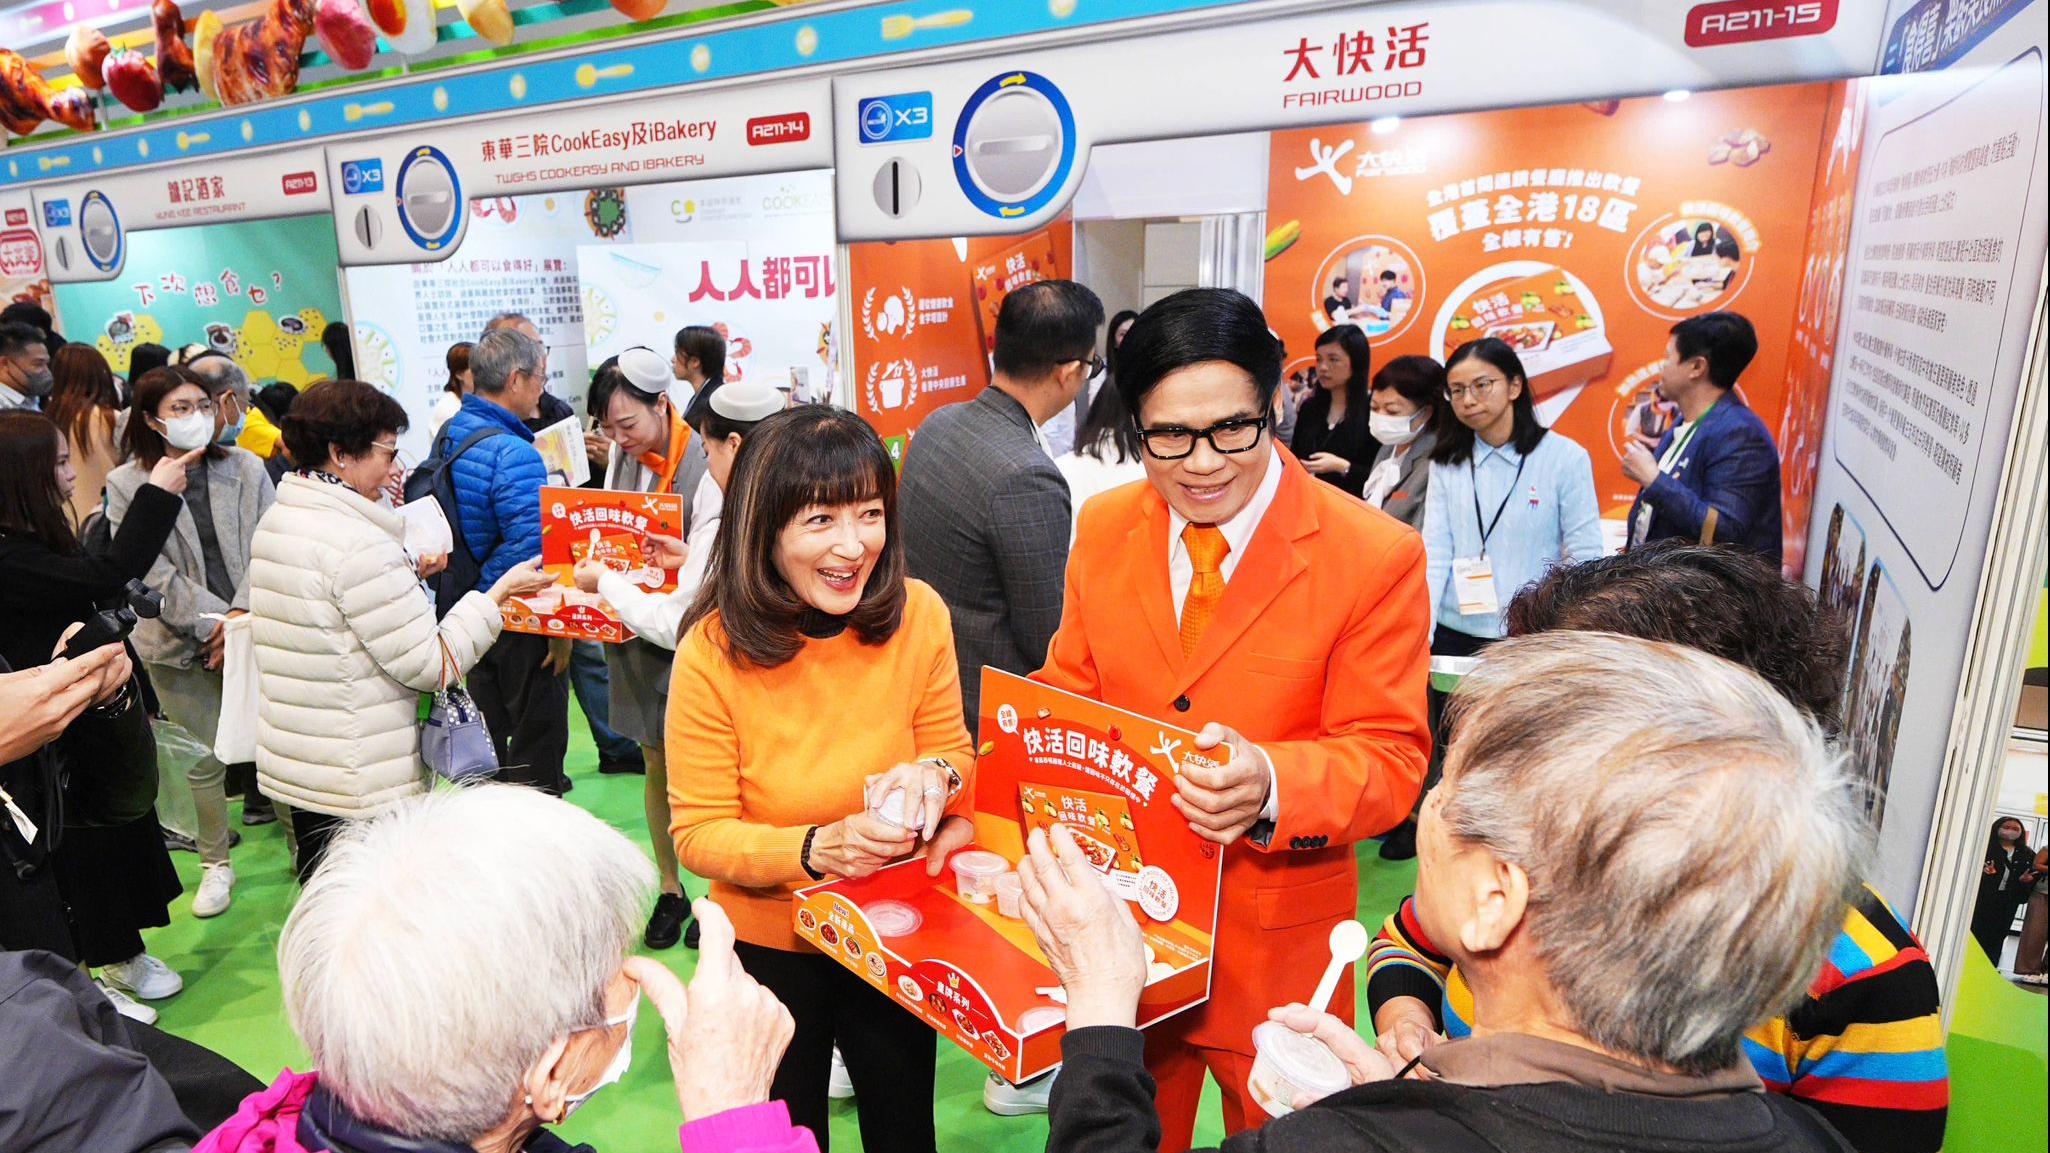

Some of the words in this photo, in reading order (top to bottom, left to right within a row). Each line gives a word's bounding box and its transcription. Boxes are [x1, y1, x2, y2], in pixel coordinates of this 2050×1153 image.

[1700, 2, 1822, 35] A211-15
[1283, 22, 1430, 83] 大快活
[1283, 81, 1423, 109] FAIRWOOD
[752, 119, 805, 140] A211-14
[895, 106, 929, 127] X3
[481, 119, 717, 163] 東華三院CookEasy及iBakery
[494, 171, 538, 185] TWGHS
[540, 164, 607, 182] COOKEASY
[609, 159, 640, 175] AND
[642, 154, 705, 171] IBAKERY
[1427, 192, 1638, 242] 覆蓋全港18區
[569, 507, 649, 532] 快活回味軟餐
[1022, 727, 1159, 801] 快活回味軟餐
[1061, 795, 1087, 812] 快活
